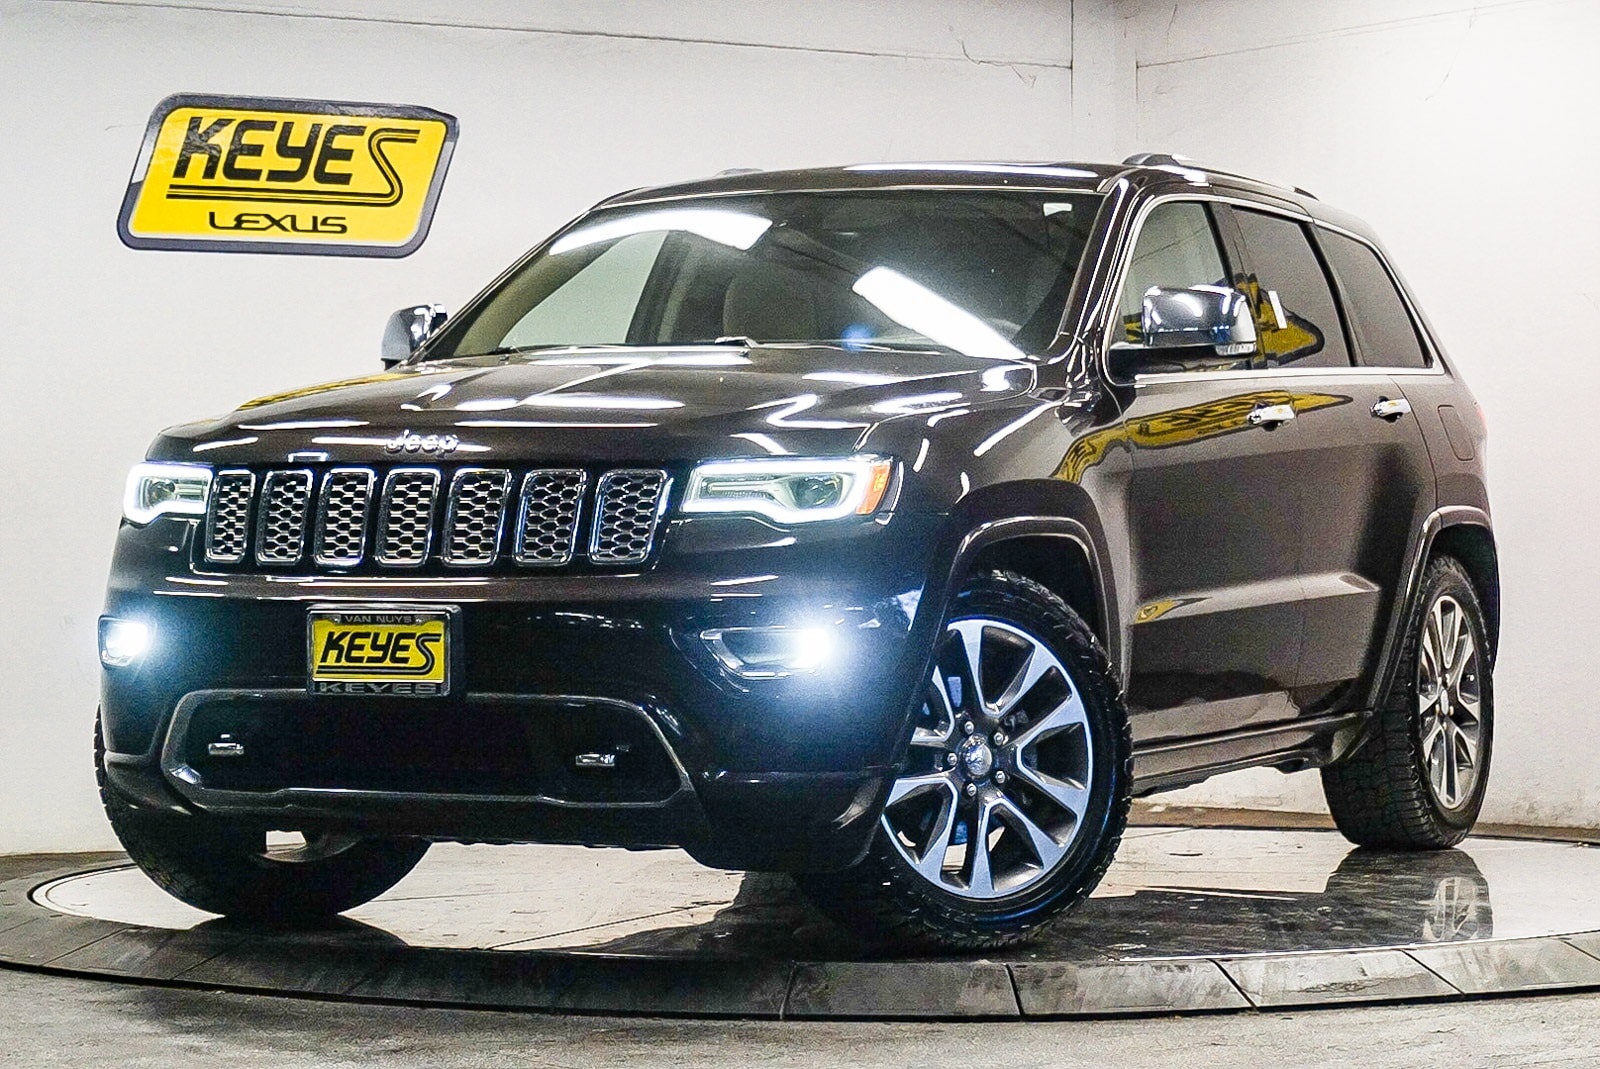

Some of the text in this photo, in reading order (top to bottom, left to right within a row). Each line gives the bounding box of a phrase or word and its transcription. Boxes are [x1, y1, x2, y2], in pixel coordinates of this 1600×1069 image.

[167, 116, 421, 207] KEYES
[208, 211, 348, 234] LEXUS
[385, 429, 458, 458] Jeep
[345, 615, 412, 623] VAN NUYS
[316, 631, 442, 676] KEYES
[319, 682, 437, 695] KEYES
